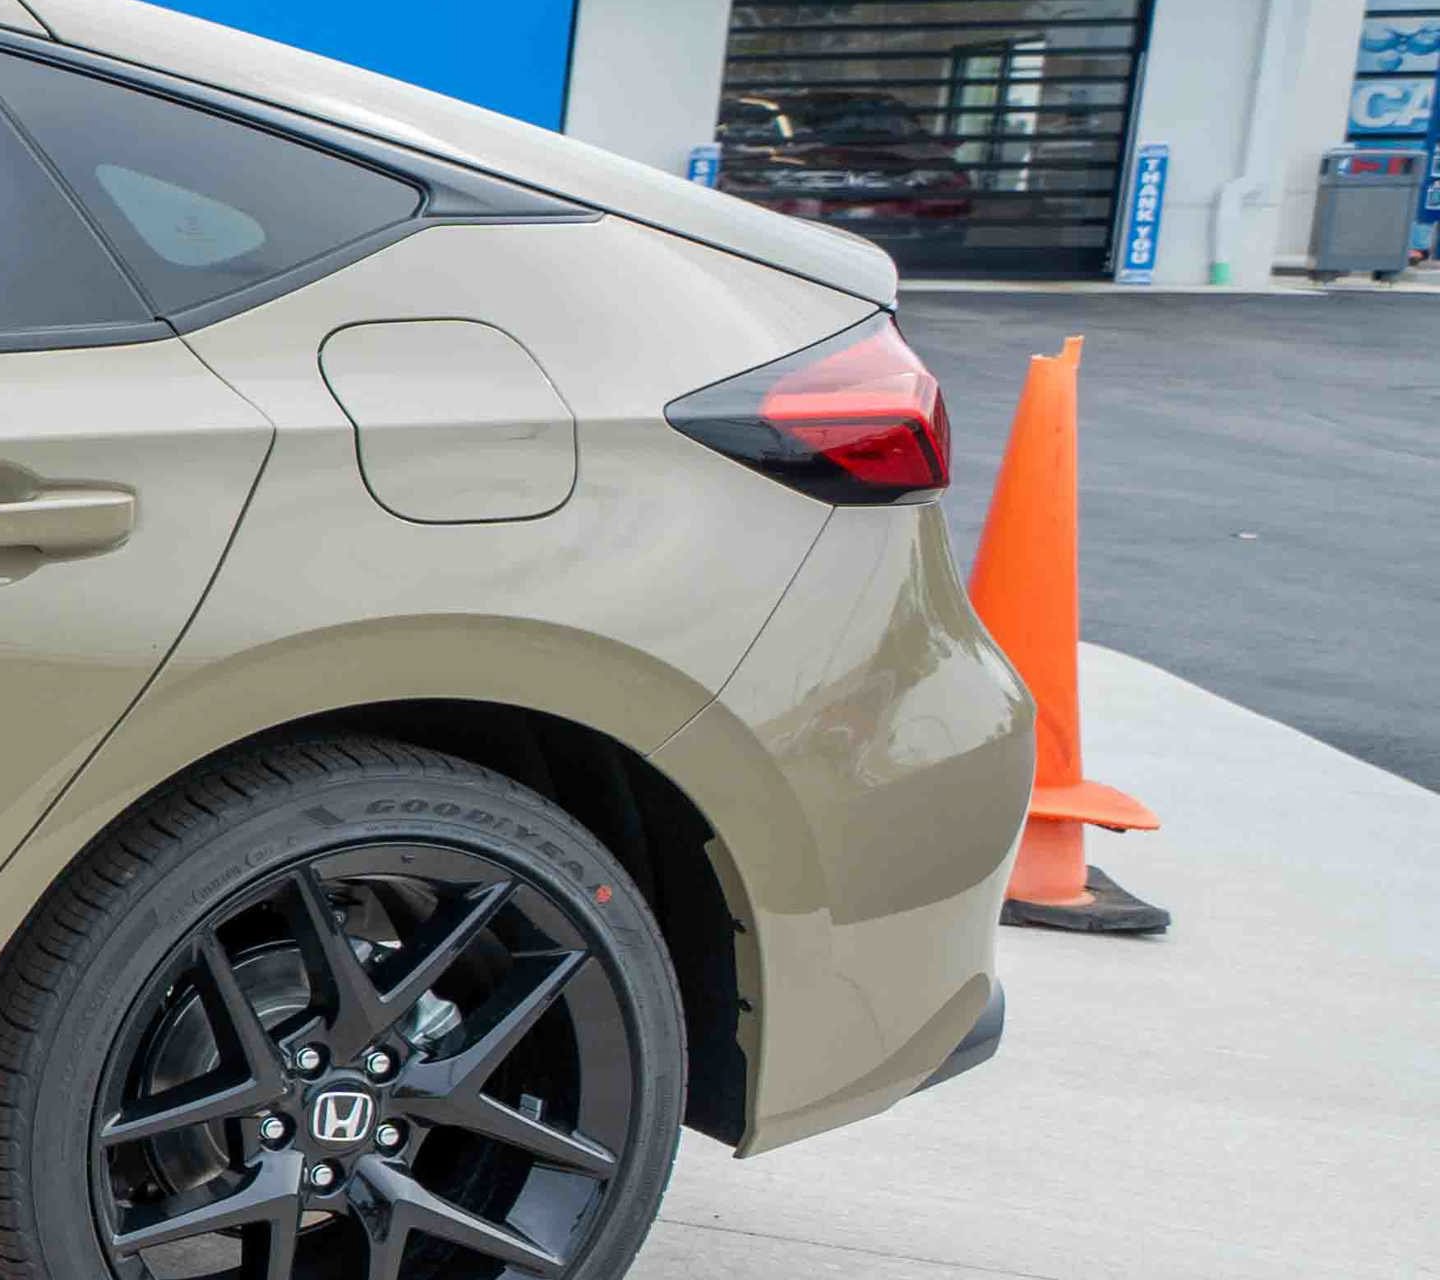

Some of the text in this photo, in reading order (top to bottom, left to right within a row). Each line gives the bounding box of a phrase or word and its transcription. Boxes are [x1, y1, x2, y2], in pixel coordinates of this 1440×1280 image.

[1131, 158, 1161, 265] THANK YOU
[363, 798, 611, 902] GOODYEA
